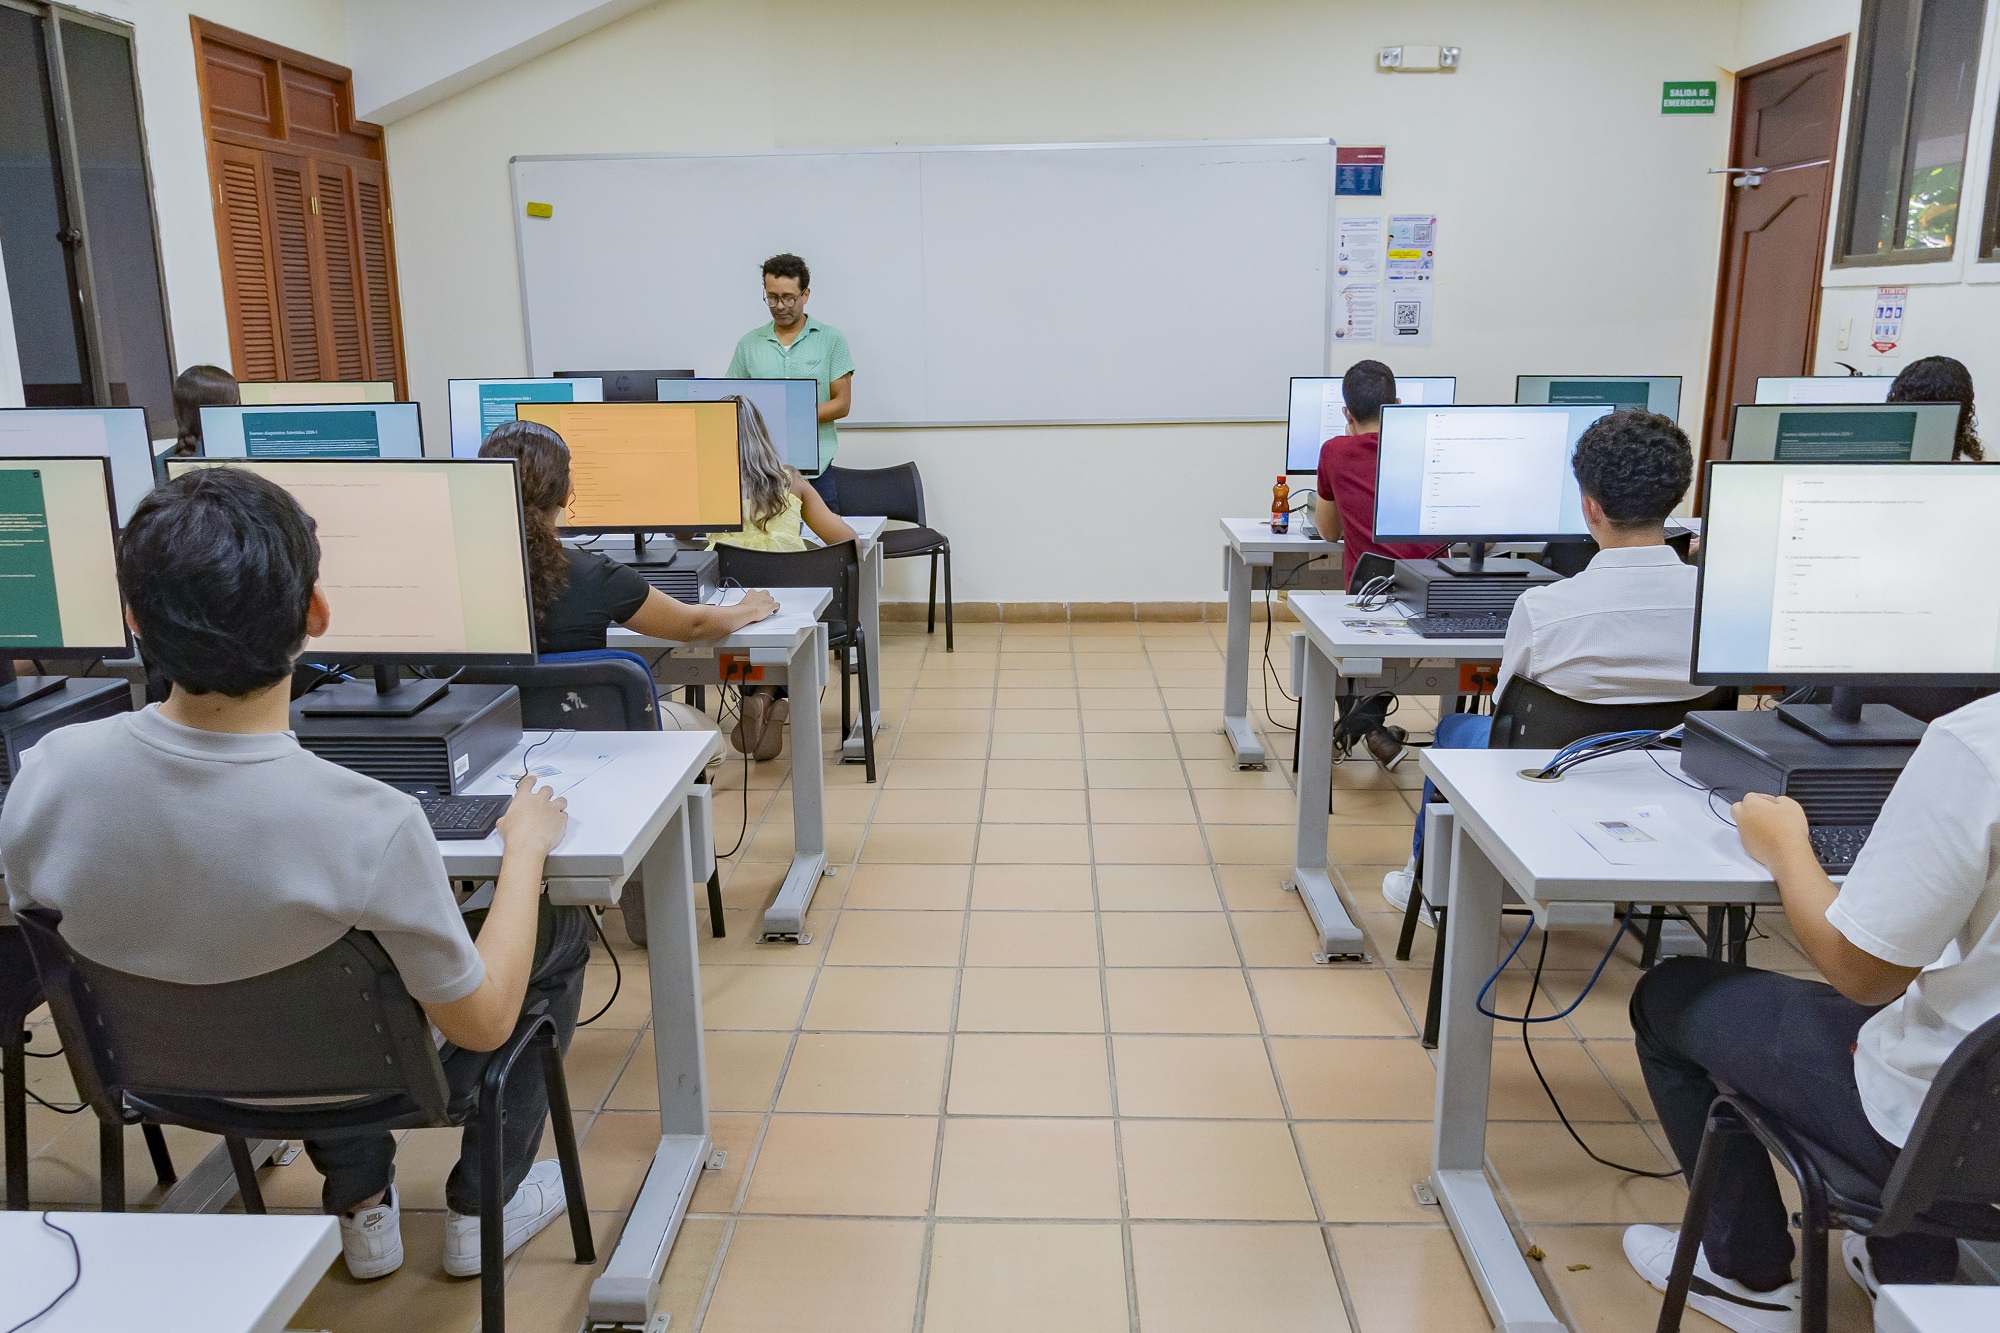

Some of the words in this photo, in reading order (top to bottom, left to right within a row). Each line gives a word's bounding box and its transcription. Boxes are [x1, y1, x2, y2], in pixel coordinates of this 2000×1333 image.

[1670, 88, 1697, 97] SALIDA
[1699, 88, 1710, 97] DE
[1663, 99, 1714, 107] EMERGENCIA
[366, 1211, 382, 1222] NIKE
[366, 1224, 383, 1233] AIR
